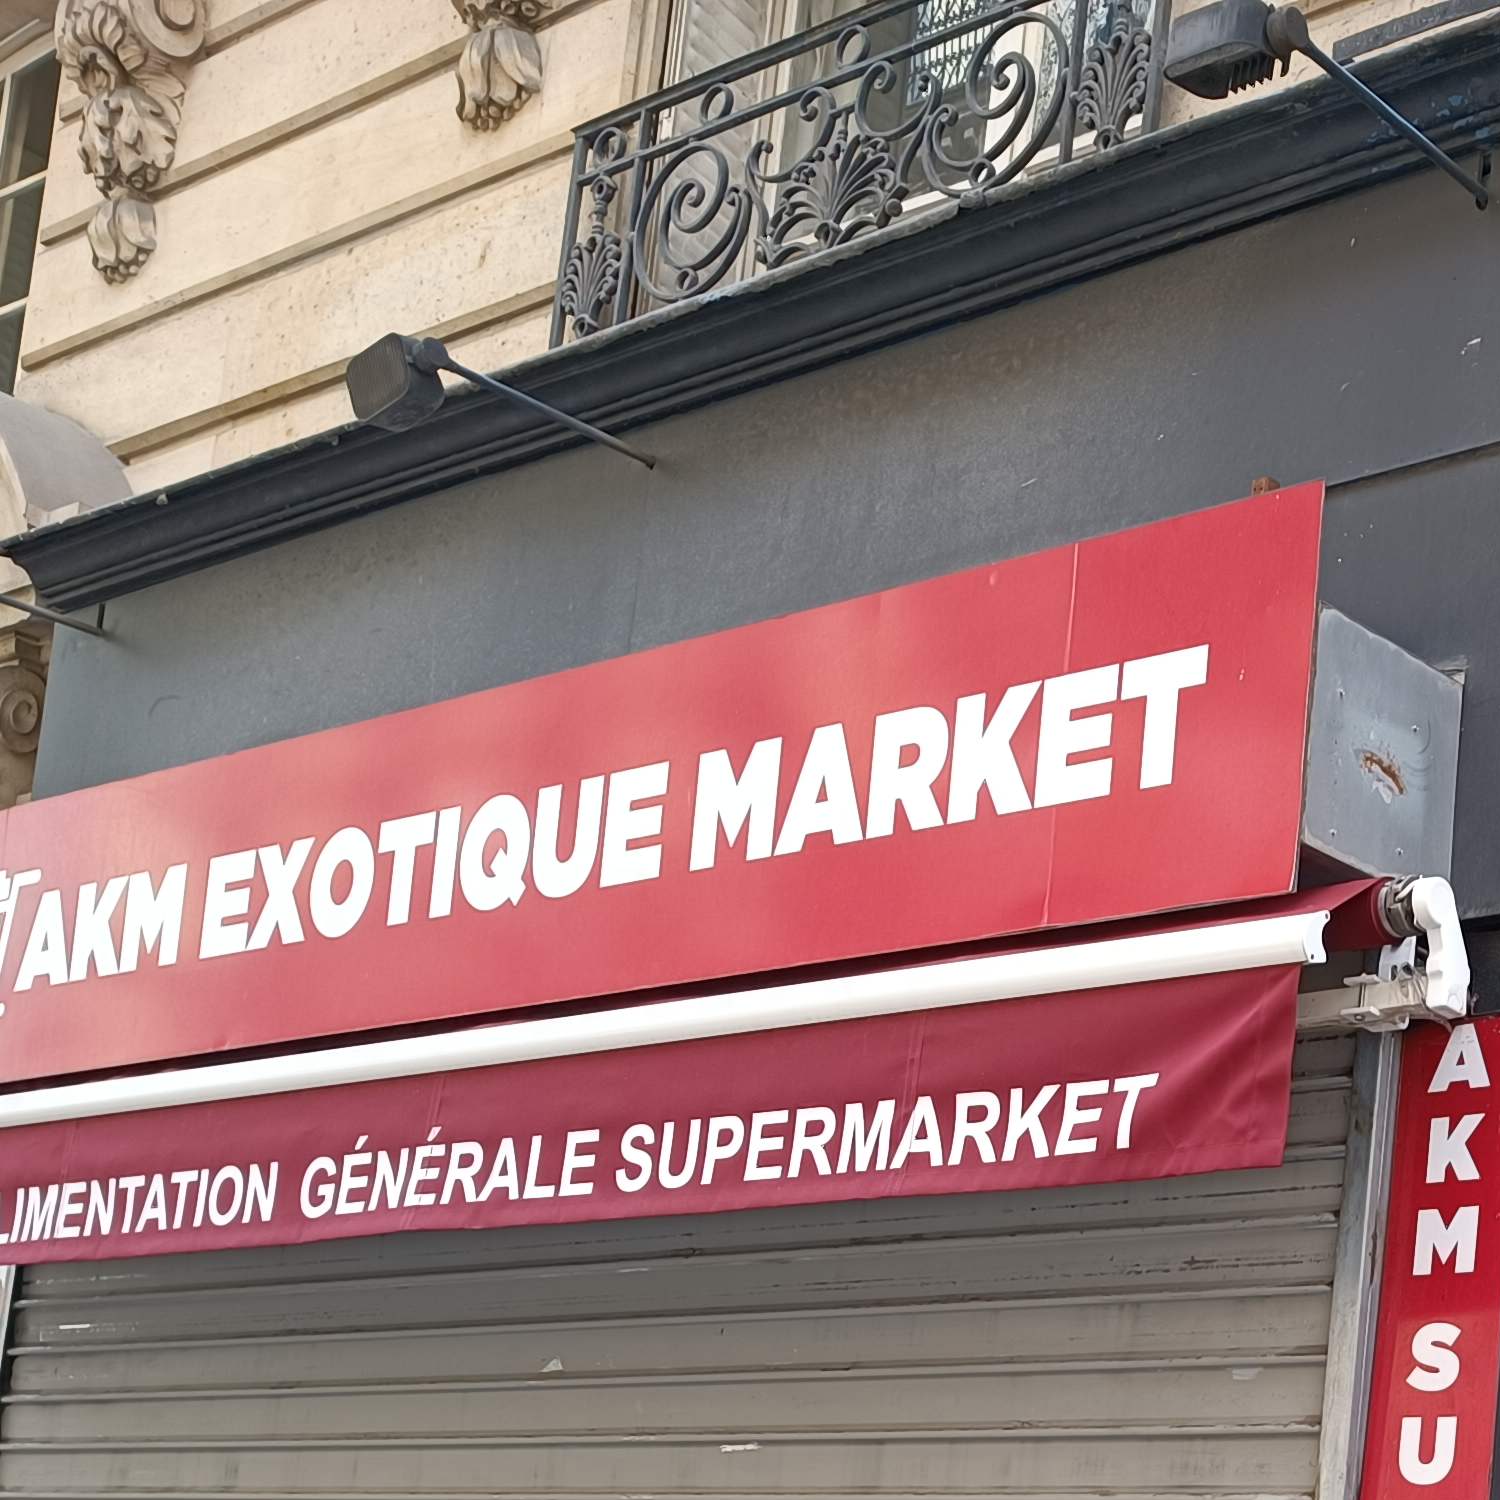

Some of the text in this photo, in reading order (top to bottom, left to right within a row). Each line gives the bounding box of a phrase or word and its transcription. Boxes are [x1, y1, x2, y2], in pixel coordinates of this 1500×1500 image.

[13, 643, 1208, 992] AKM EXOTIQUE MARKET
[300, 1123, 599, 1217] GÉNÉRALE
[615, 1072, 1159, 1195] SUPERMARKET
